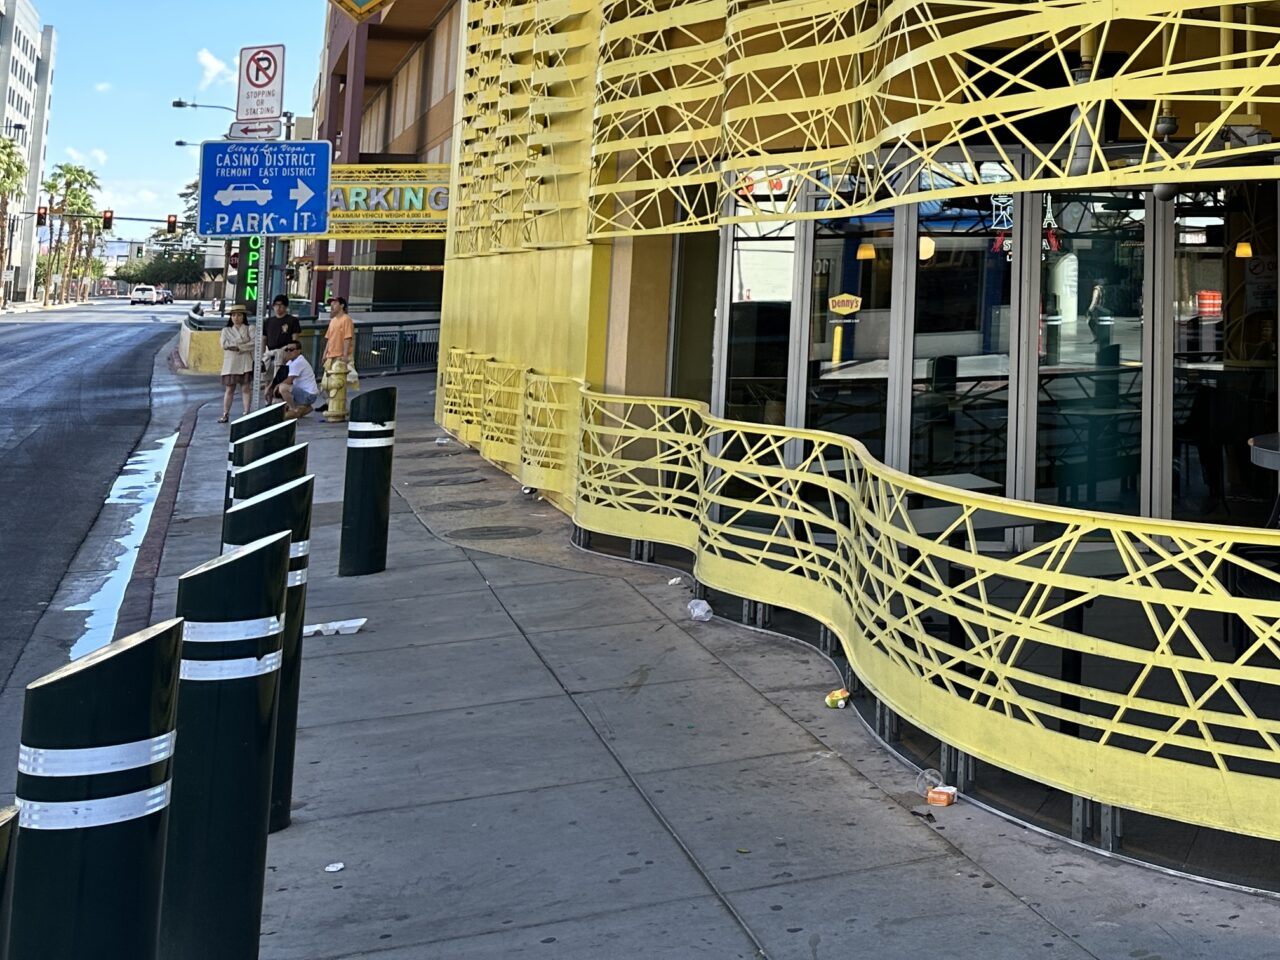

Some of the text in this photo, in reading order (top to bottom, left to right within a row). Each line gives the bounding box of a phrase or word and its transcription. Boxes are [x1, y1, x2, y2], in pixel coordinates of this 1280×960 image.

[246, 90, 276, 100] STOPPING
[256, 99, 265, 107] OR
[227, 144, 247, 153] City
[250, 144, 259, 153] of
[280, 144, 306, 153] Vegas
[216, 153, 316, 167] CASINO DISTRICT
[216, 167, 316, 177] FREMONT EAST DISTRICT
[330, 187, 450, 211] ARKING
[216, 213, 275, 233] PARK
[245, 235, 262, 301] OPEN
[832, 298, 859, 309] Denny's
